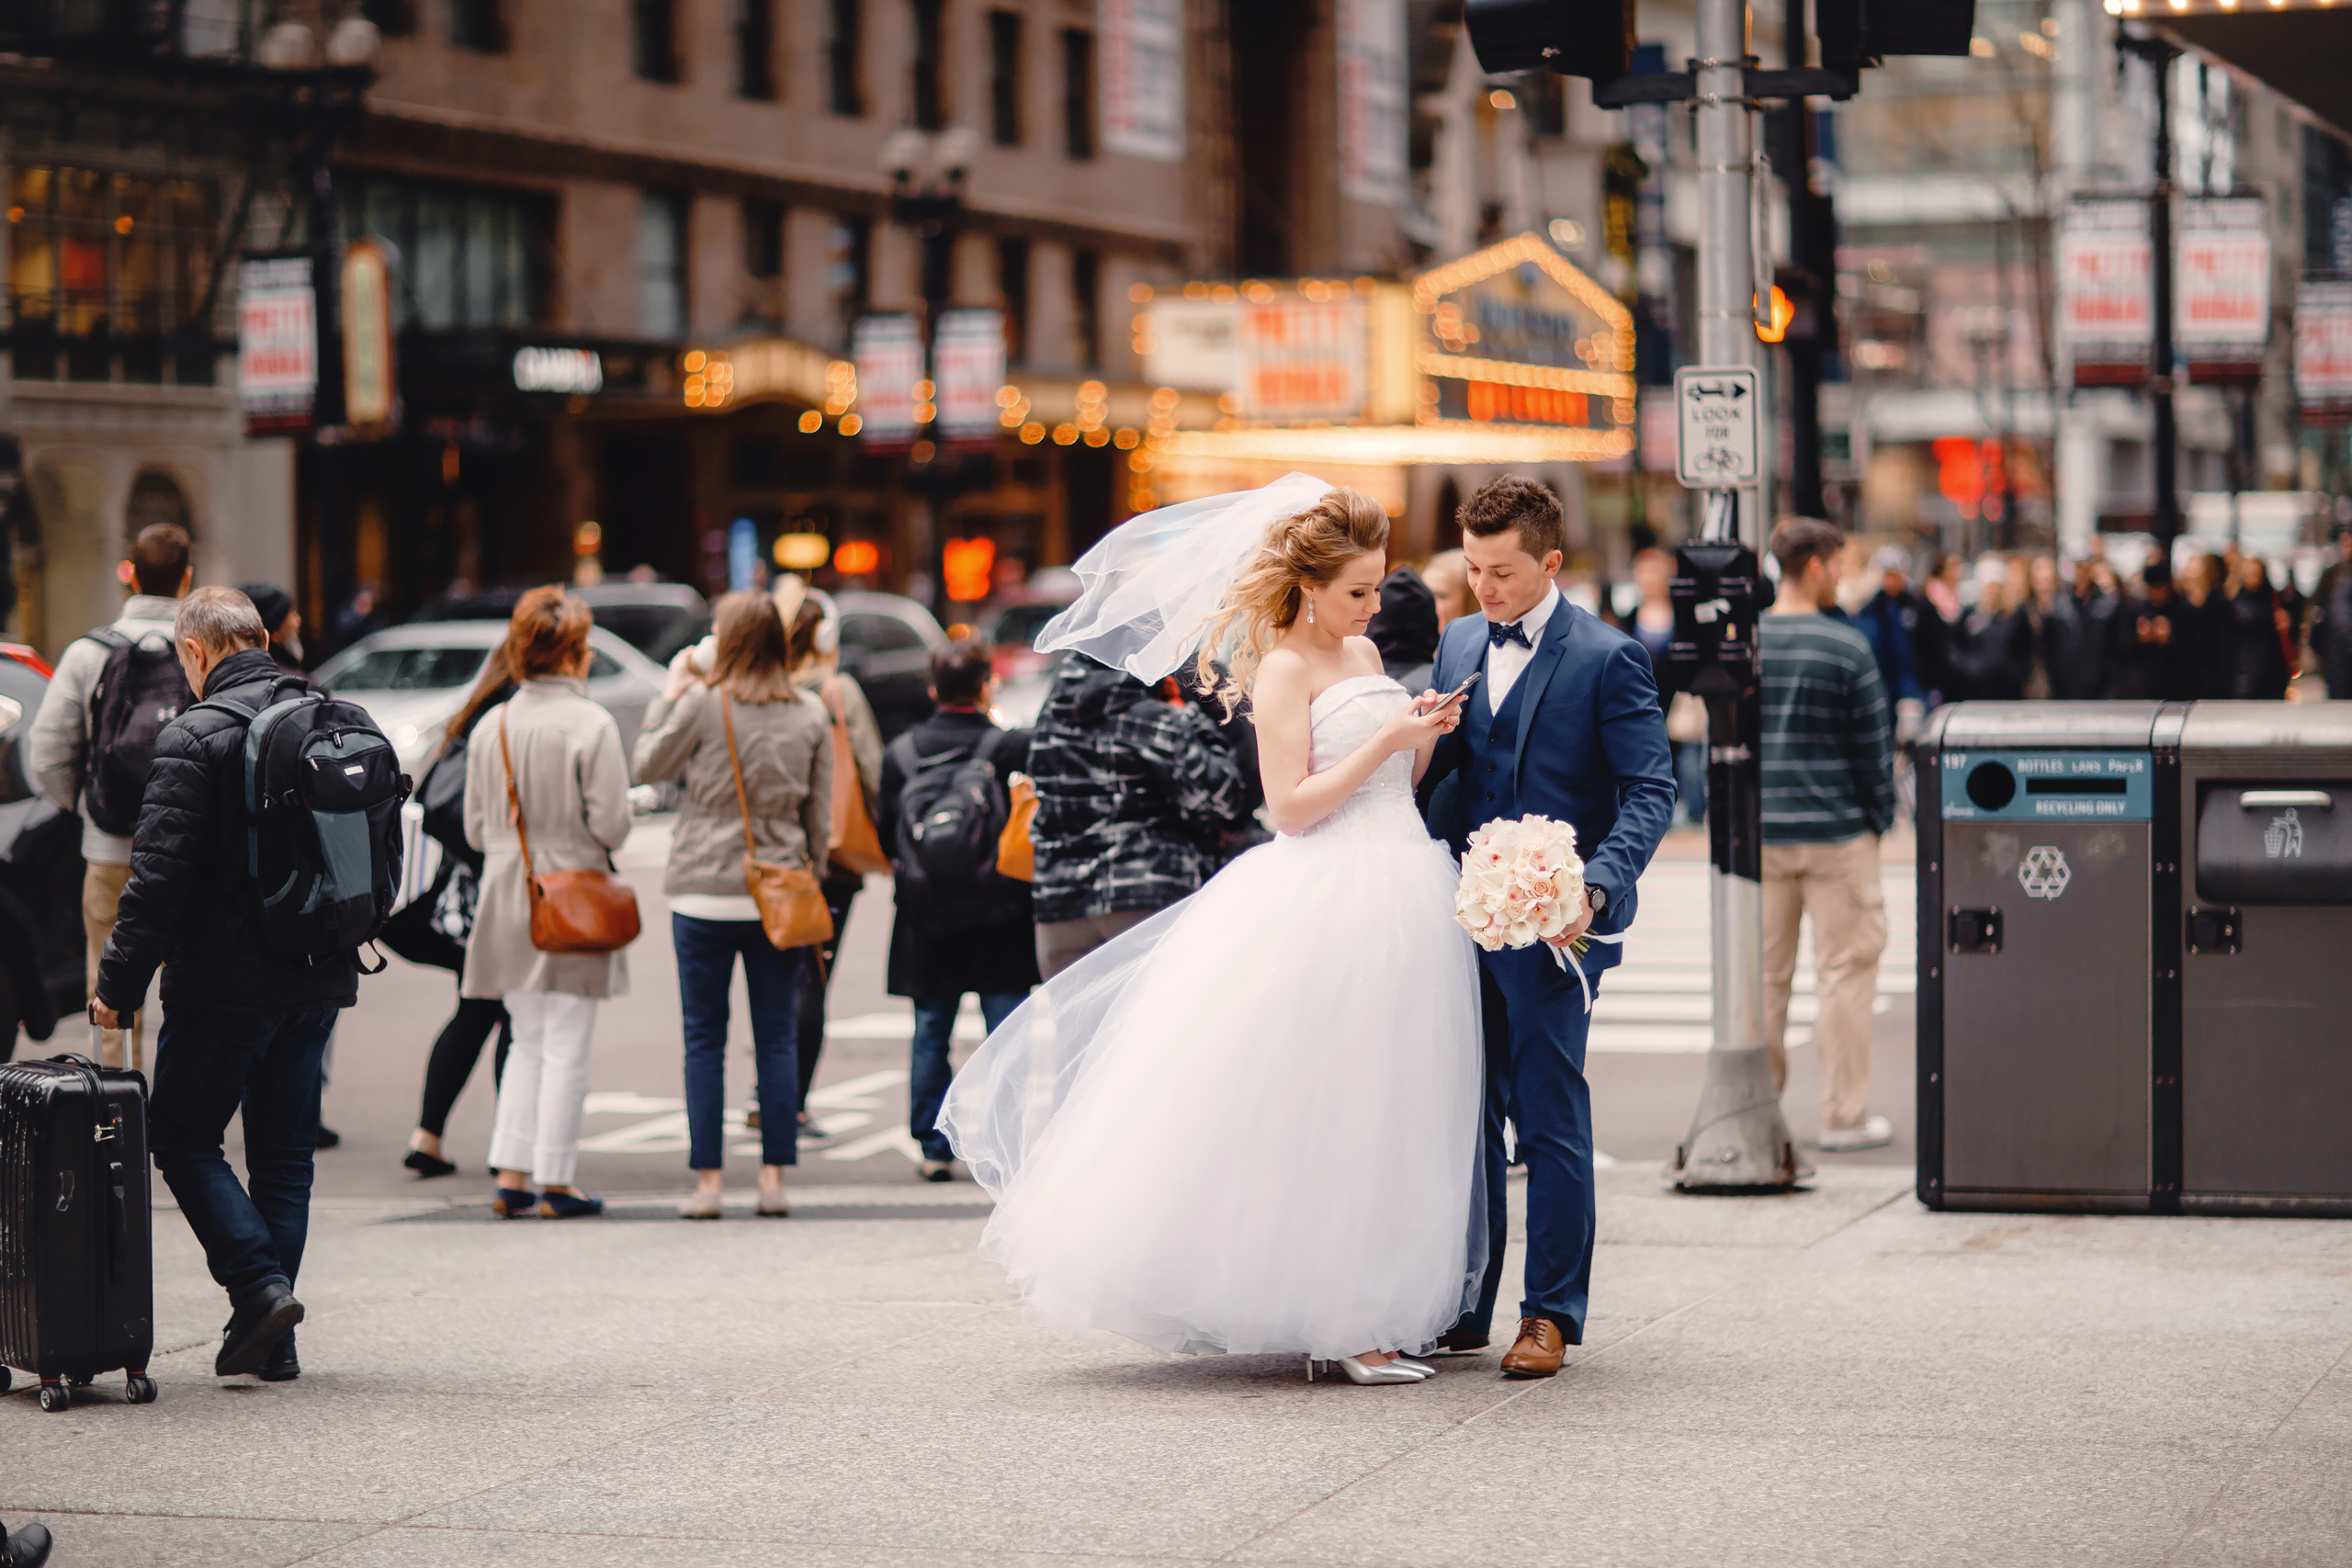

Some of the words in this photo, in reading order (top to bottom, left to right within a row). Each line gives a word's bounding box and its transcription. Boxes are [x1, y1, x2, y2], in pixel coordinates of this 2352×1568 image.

[1692, 406, 1743, 423] LOOK
[1705, 425, 1729, 440] FOR
[2017, 758, 2064, 773] BOTTLES
[2035, 800, 2094, 816] RECYCLING
[2096, 800, 2126, 816] ONLY
